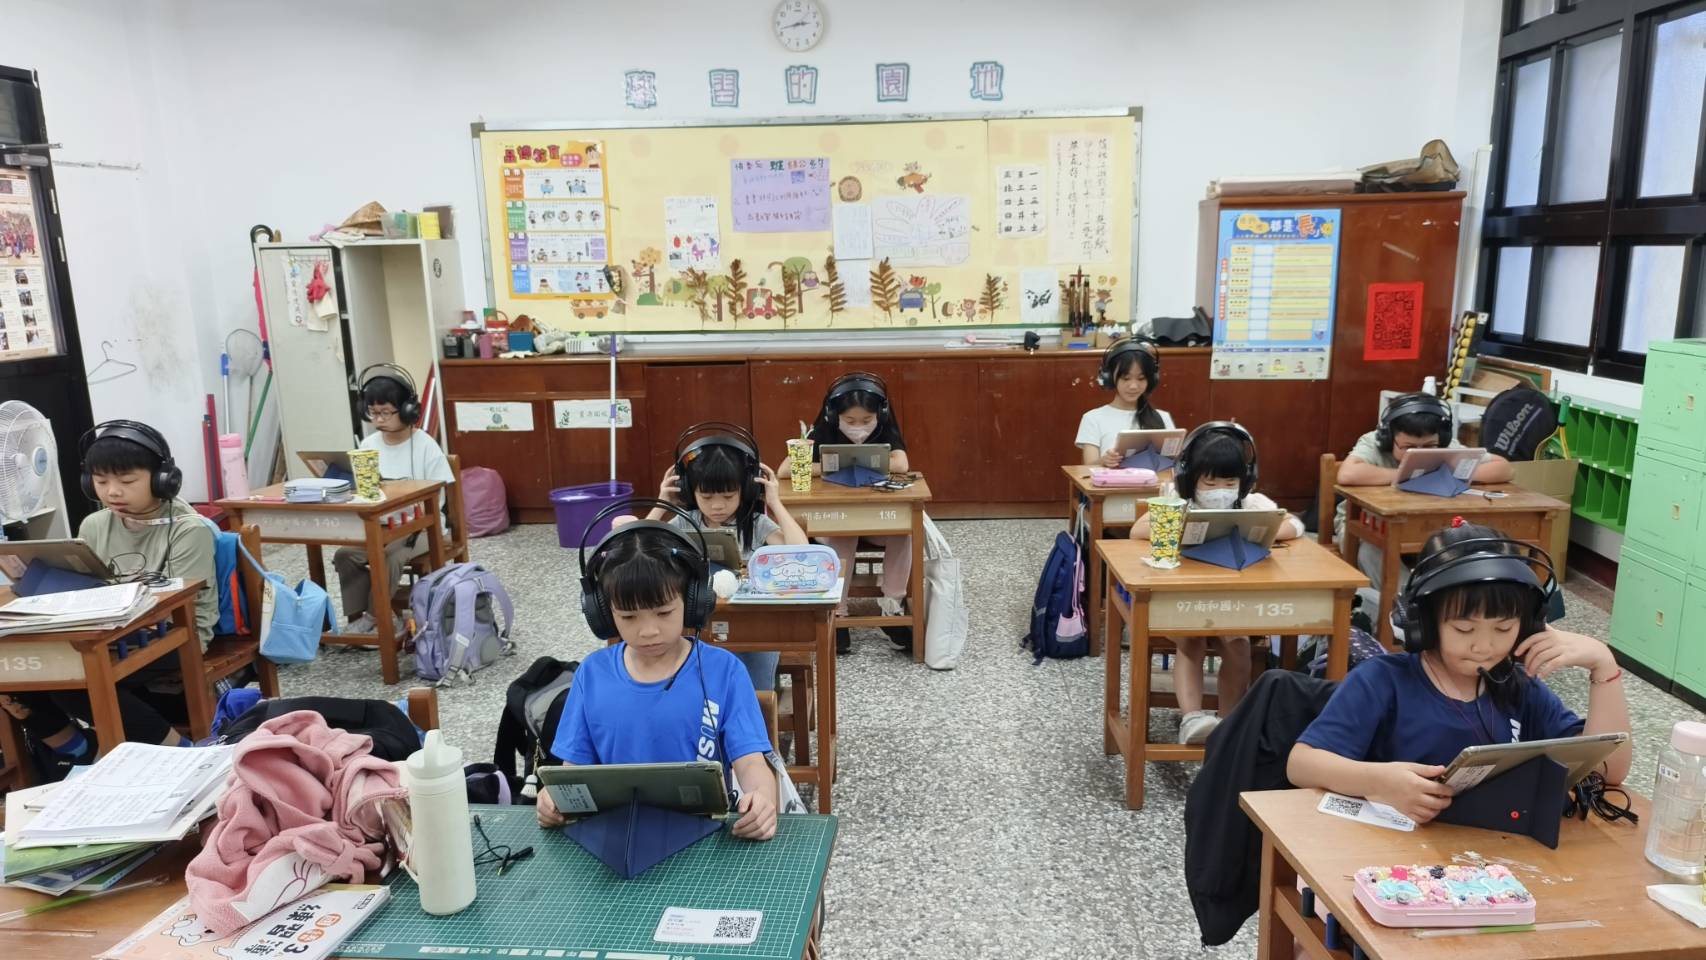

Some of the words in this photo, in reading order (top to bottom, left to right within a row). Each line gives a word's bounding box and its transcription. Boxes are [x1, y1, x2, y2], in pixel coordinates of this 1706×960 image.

[1493, 403, 1534, 451] Wilson
[1254, 602, 1295, 617] 135
[0, 656, 42, 671] 135
